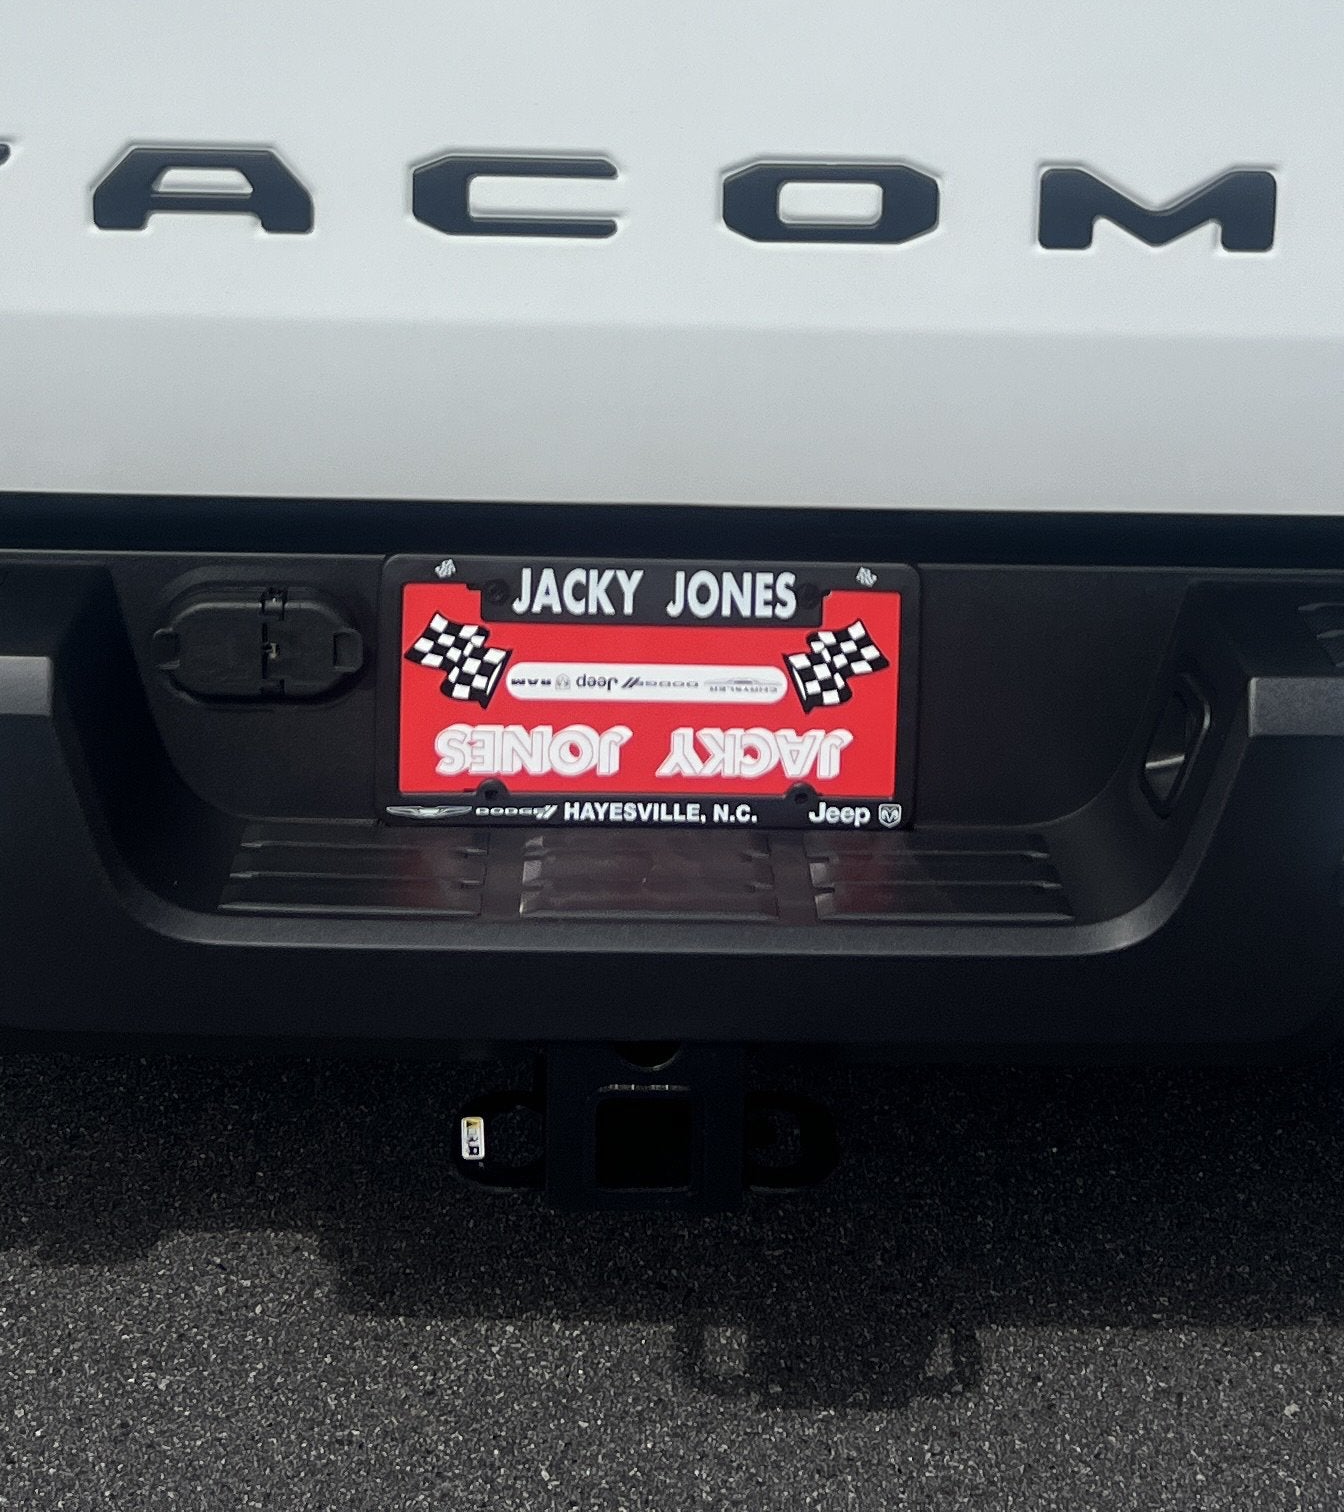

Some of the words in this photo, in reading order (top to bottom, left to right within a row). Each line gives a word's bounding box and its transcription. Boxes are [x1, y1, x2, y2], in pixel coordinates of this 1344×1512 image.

[512, 567, 644, 617] JACKY
[666, 570, 797, 620] JONES
[575, 674, 619, 691] Jeep
[434, 723, 634, 777] JONES
[655, 727, 854, 779] JACKY
[563, 801, 707, 824] HAYESVILLE,
[712, 803, 759, 824] N.C.
[808, 801, 872, 828] Jeep
